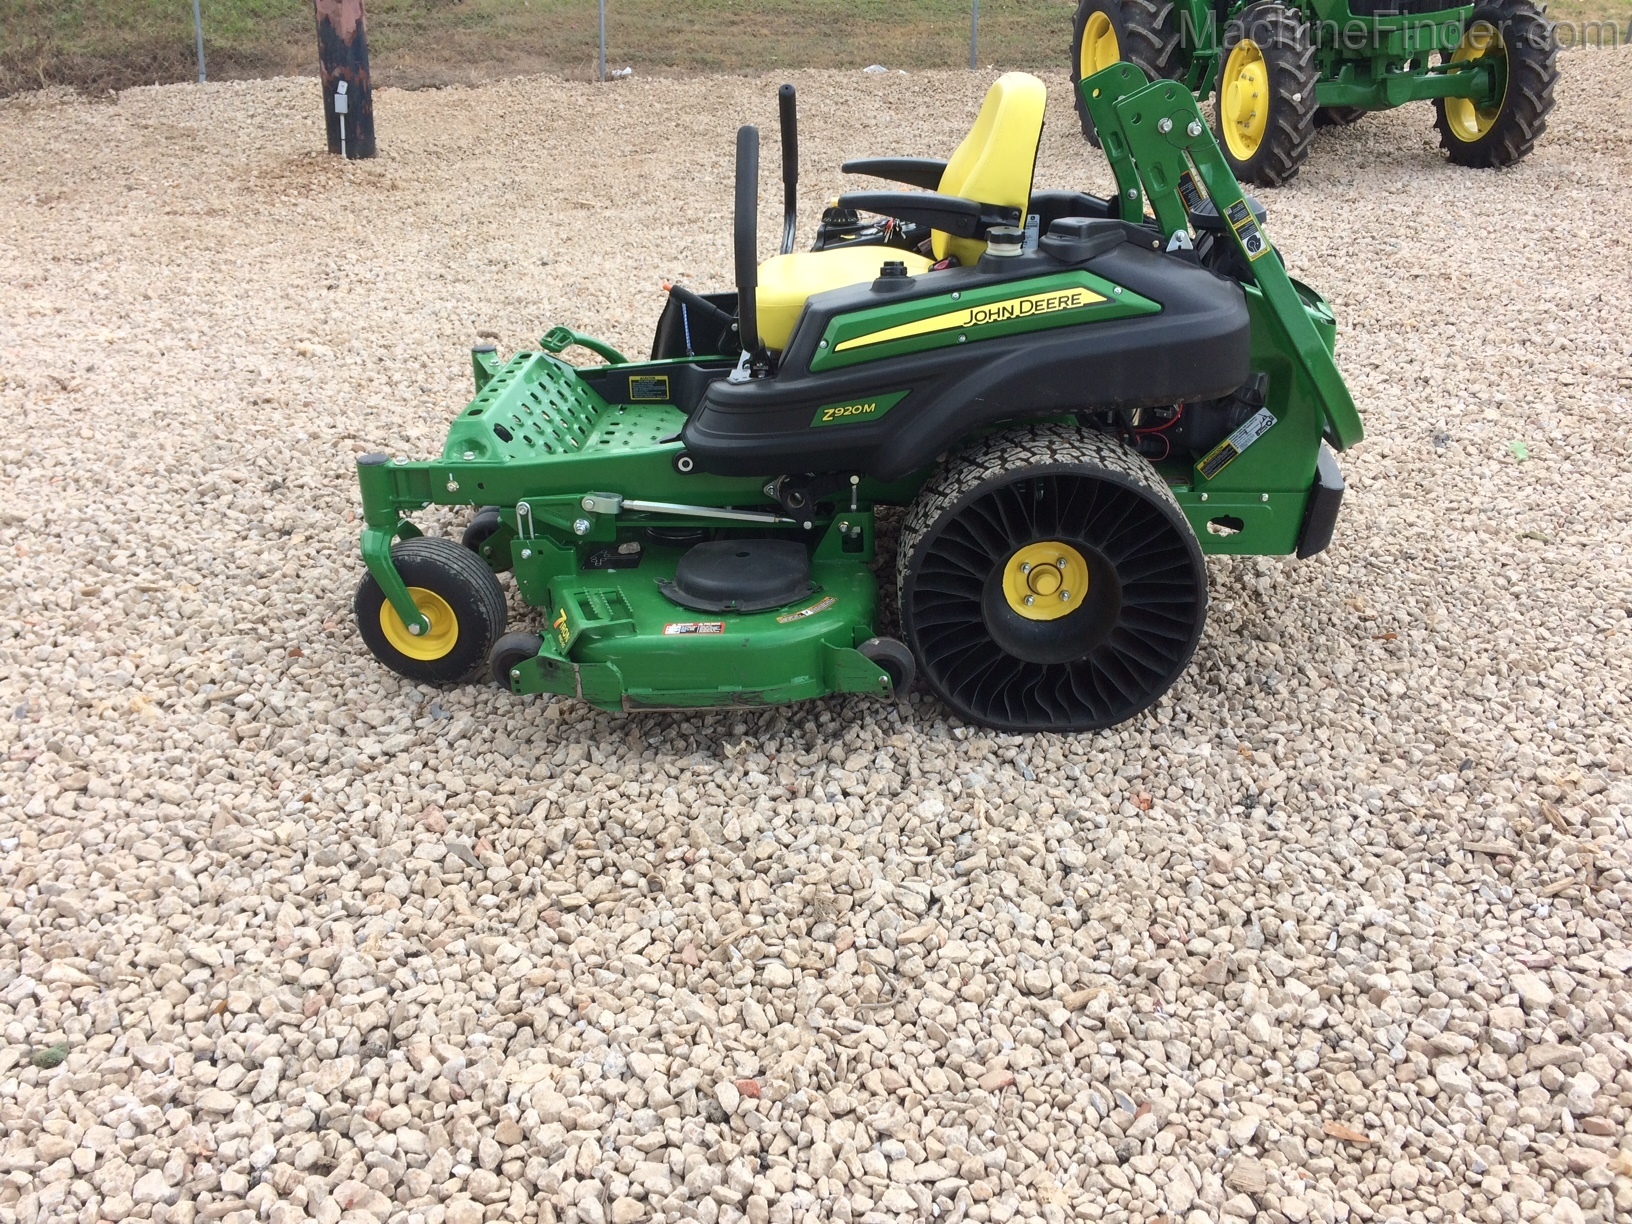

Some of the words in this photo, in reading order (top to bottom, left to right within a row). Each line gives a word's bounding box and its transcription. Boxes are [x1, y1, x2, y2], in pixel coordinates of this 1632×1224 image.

[963, 304, 1014, 325] JOHN
[1019, 293, 1082, 315] DEERE
[822, 402, 876, 421] Z920M
